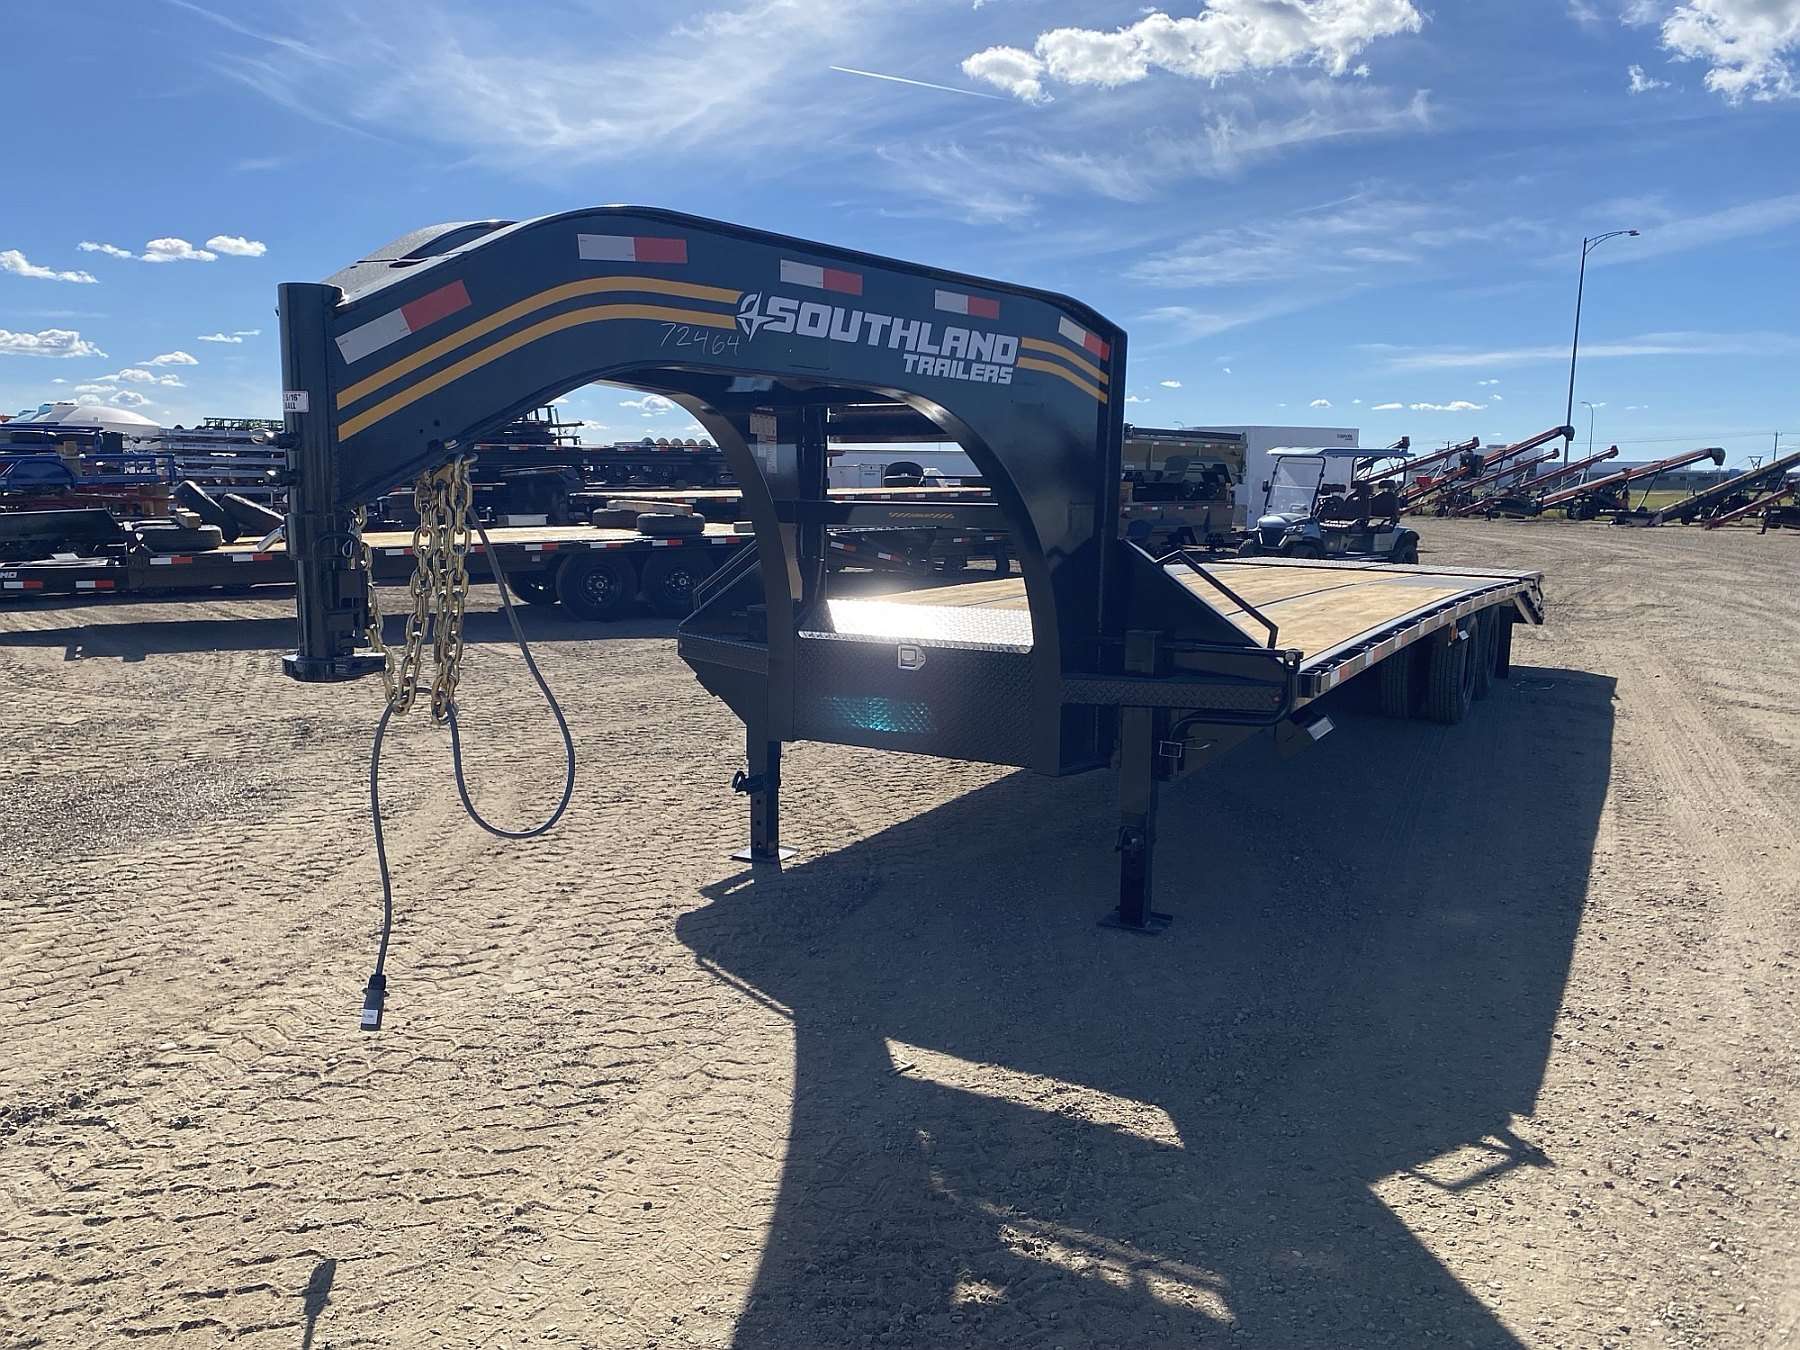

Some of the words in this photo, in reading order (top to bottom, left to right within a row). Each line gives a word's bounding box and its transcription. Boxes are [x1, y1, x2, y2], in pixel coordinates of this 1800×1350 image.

[660, 322, 740, 356] 72464
[763, 296, 1019, 364] SOUTHLAND
[903, 353, 1013, 385] TRAILERS
